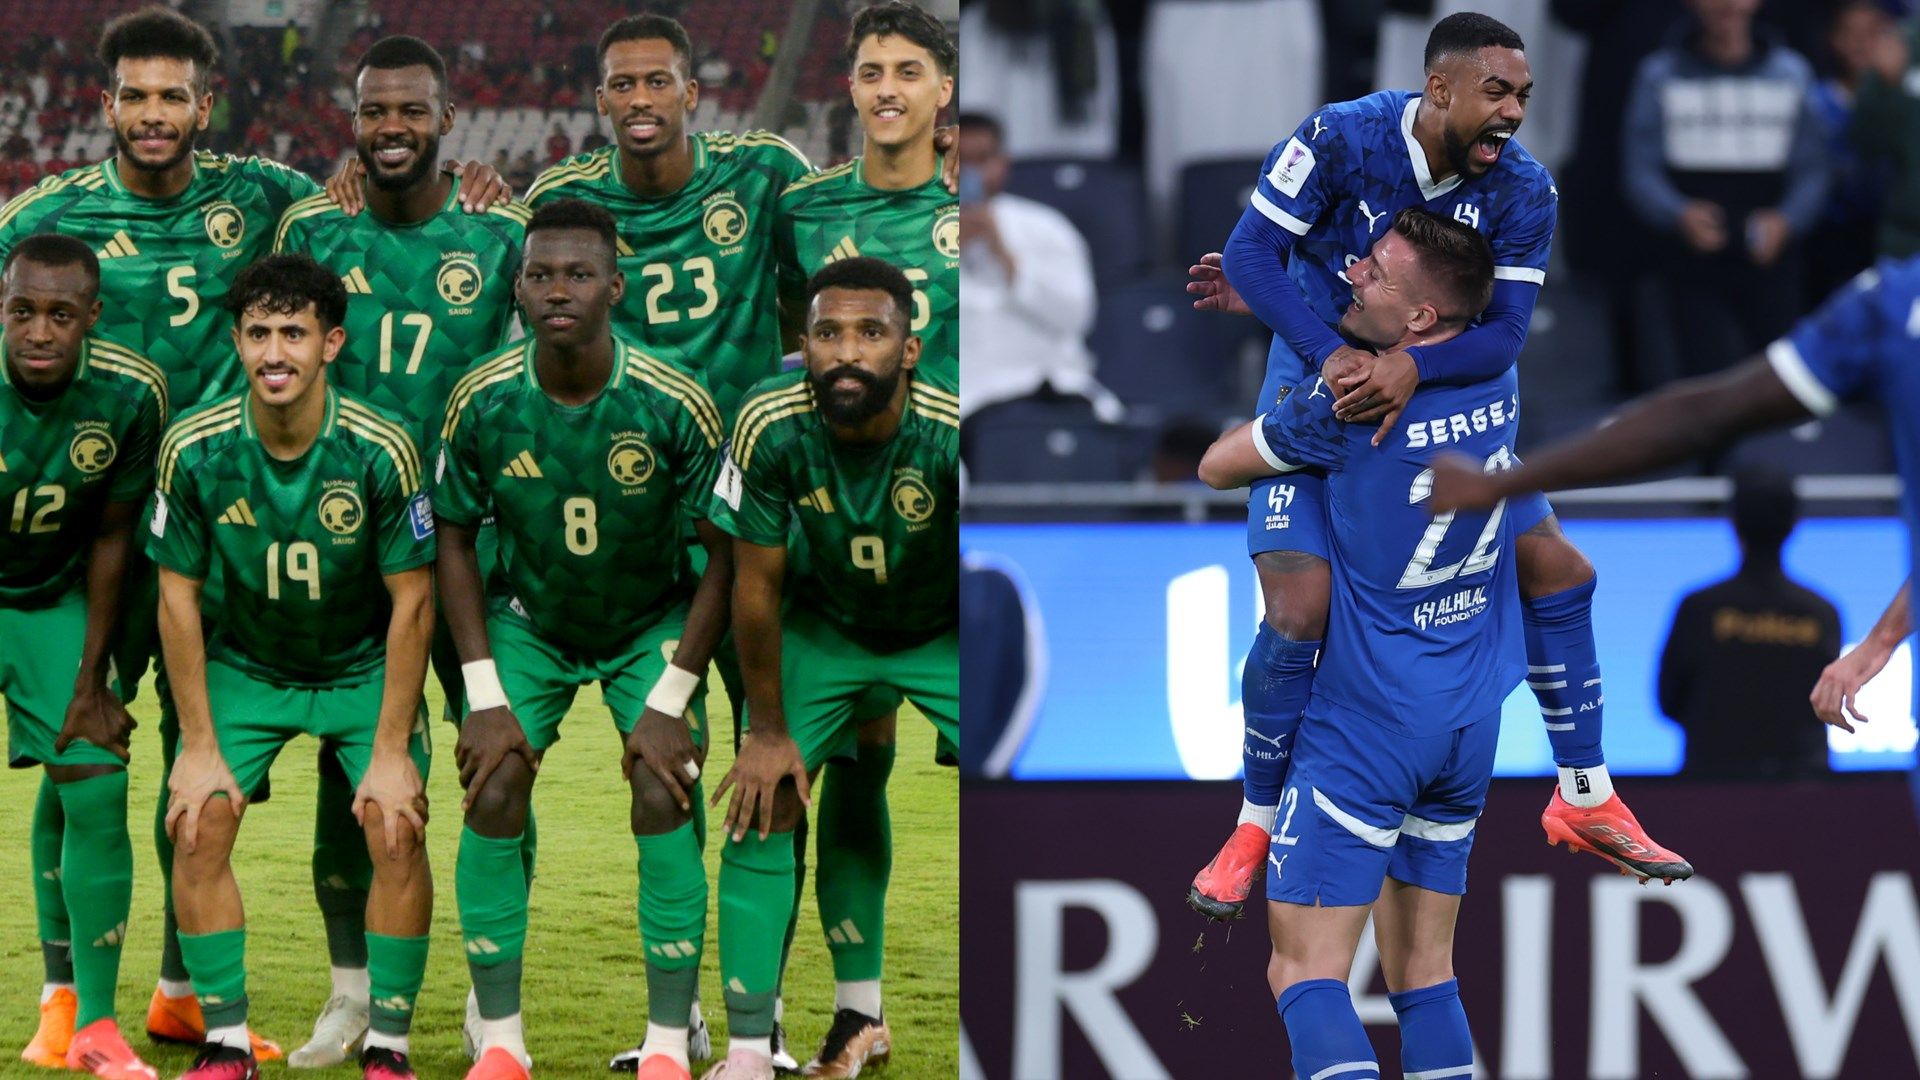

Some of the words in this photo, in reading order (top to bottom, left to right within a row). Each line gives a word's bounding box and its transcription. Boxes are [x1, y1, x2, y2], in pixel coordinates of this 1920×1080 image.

[222, 250, 243, 259] SAUDI
[718, 246, 743, 257] SAUDI
[167, 265, 199, 327] 5
[447, 308, 473, 317] SAUDI
[641, 256, 719, 325] 23
[379, 311, 433, 375] 17
[1406, 394, 1517, 448] SERGEJ
[10, 485, 66, 534] 12
[622, 488, 647, 496] SAUDI
[1396, 444, 1512, 589] 22
[563, 497, 598, 556] 8
[906, 523, 931, 532] SAUDI
[266, 541, 321, 600] 19
[850, 536, 889, 585] 9
[1588, 825, 1648, 854] F50
